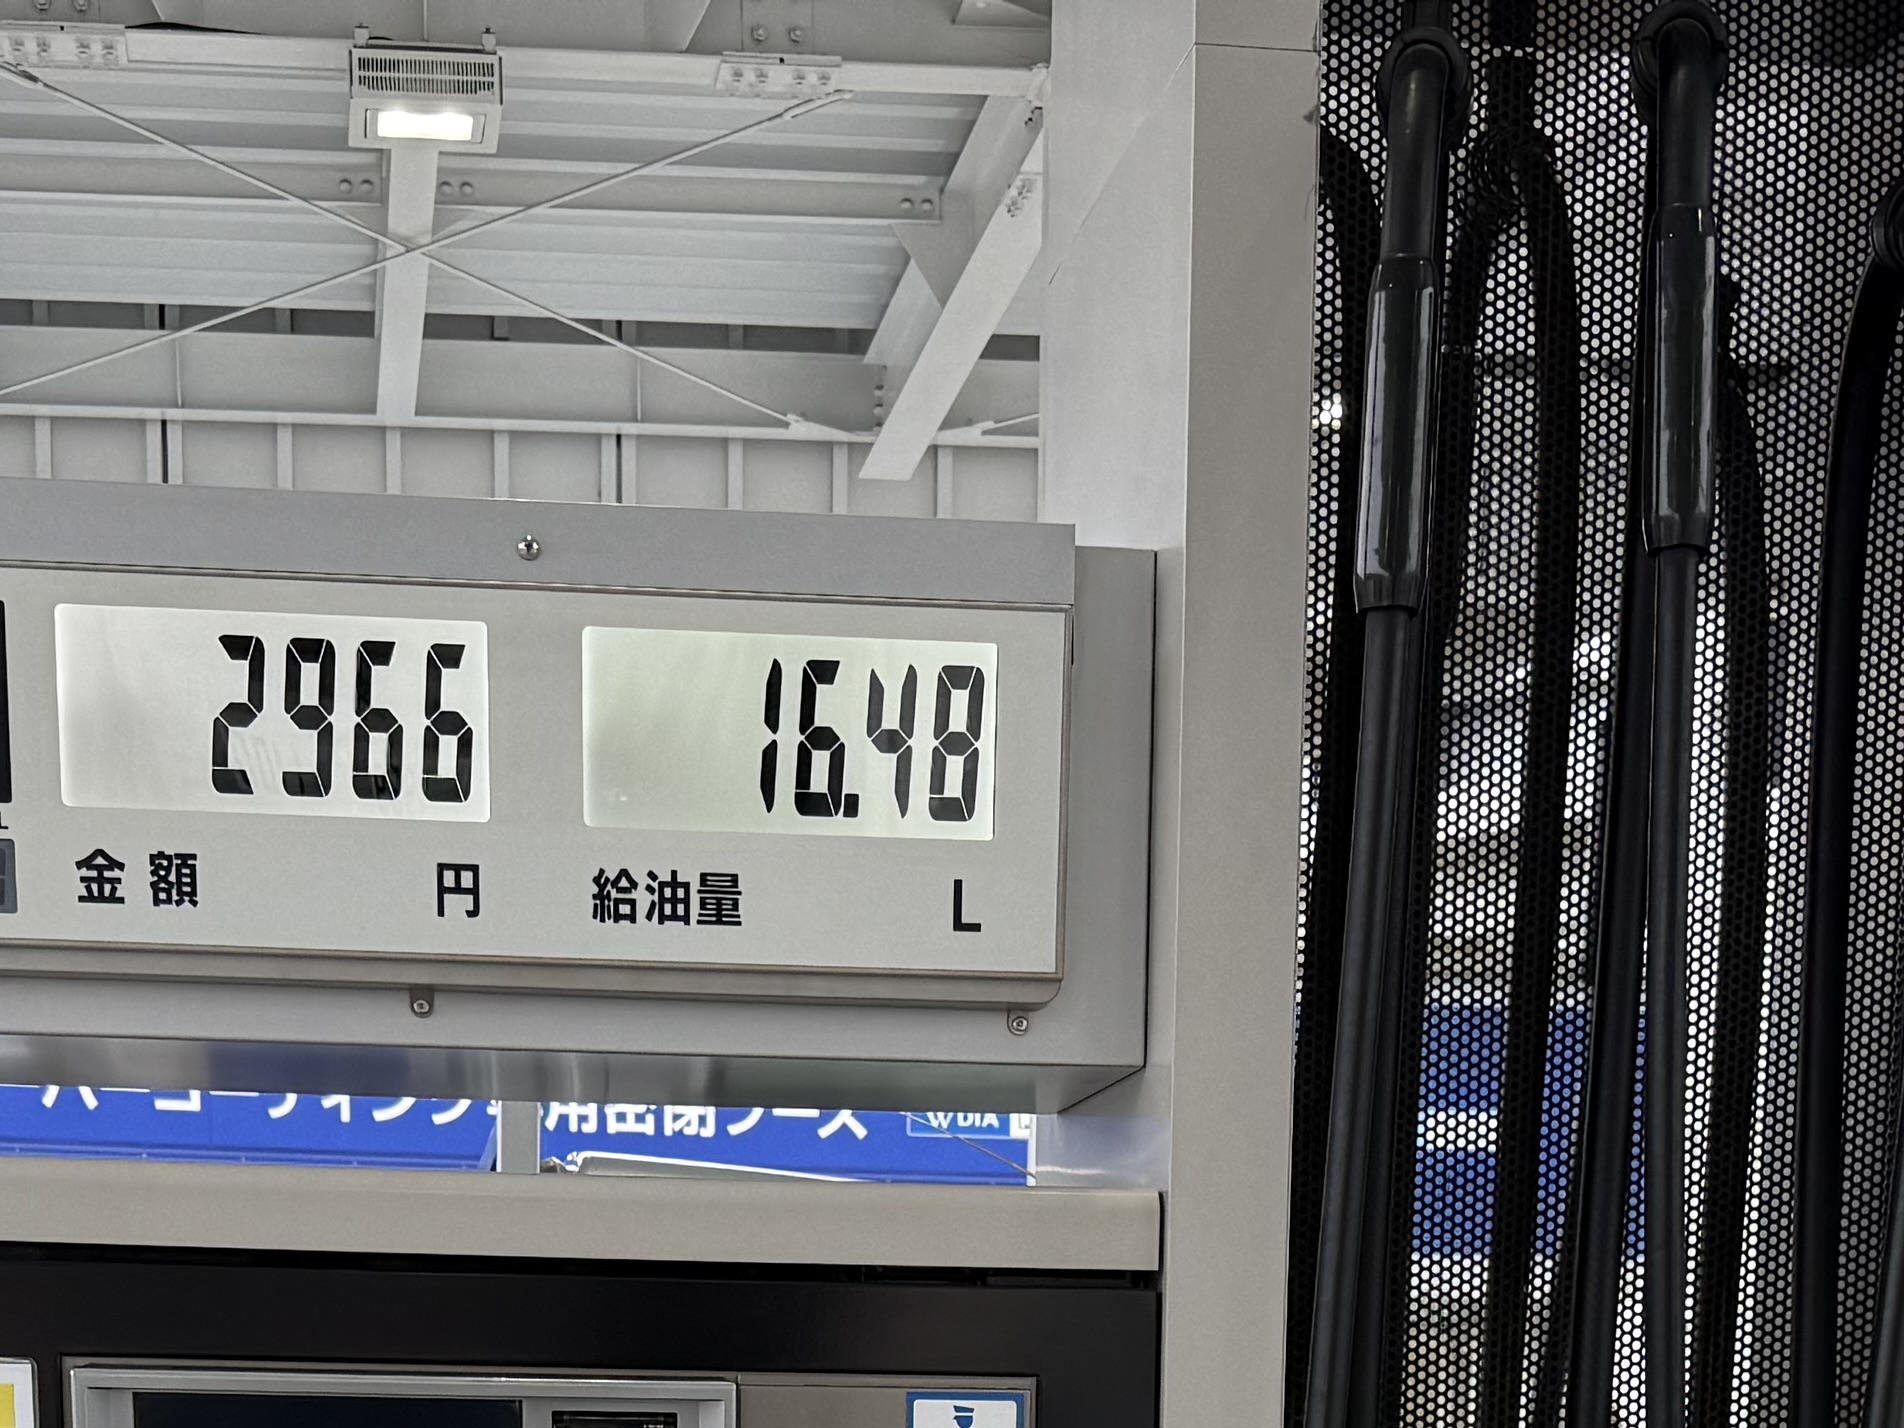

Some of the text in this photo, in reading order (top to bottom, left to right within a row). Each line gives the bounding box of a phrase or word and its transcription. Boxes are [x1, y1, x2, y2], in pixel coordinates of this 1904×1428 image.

[212, 634, 472, 803] 2966
[761, 658, 986, 821] 16.48
[75, 849, 198, 907] 金額
[437, 863, 480, 918] 円
[592, 868, 742, 926] 給油量
[953, 879, 981, 932] L
